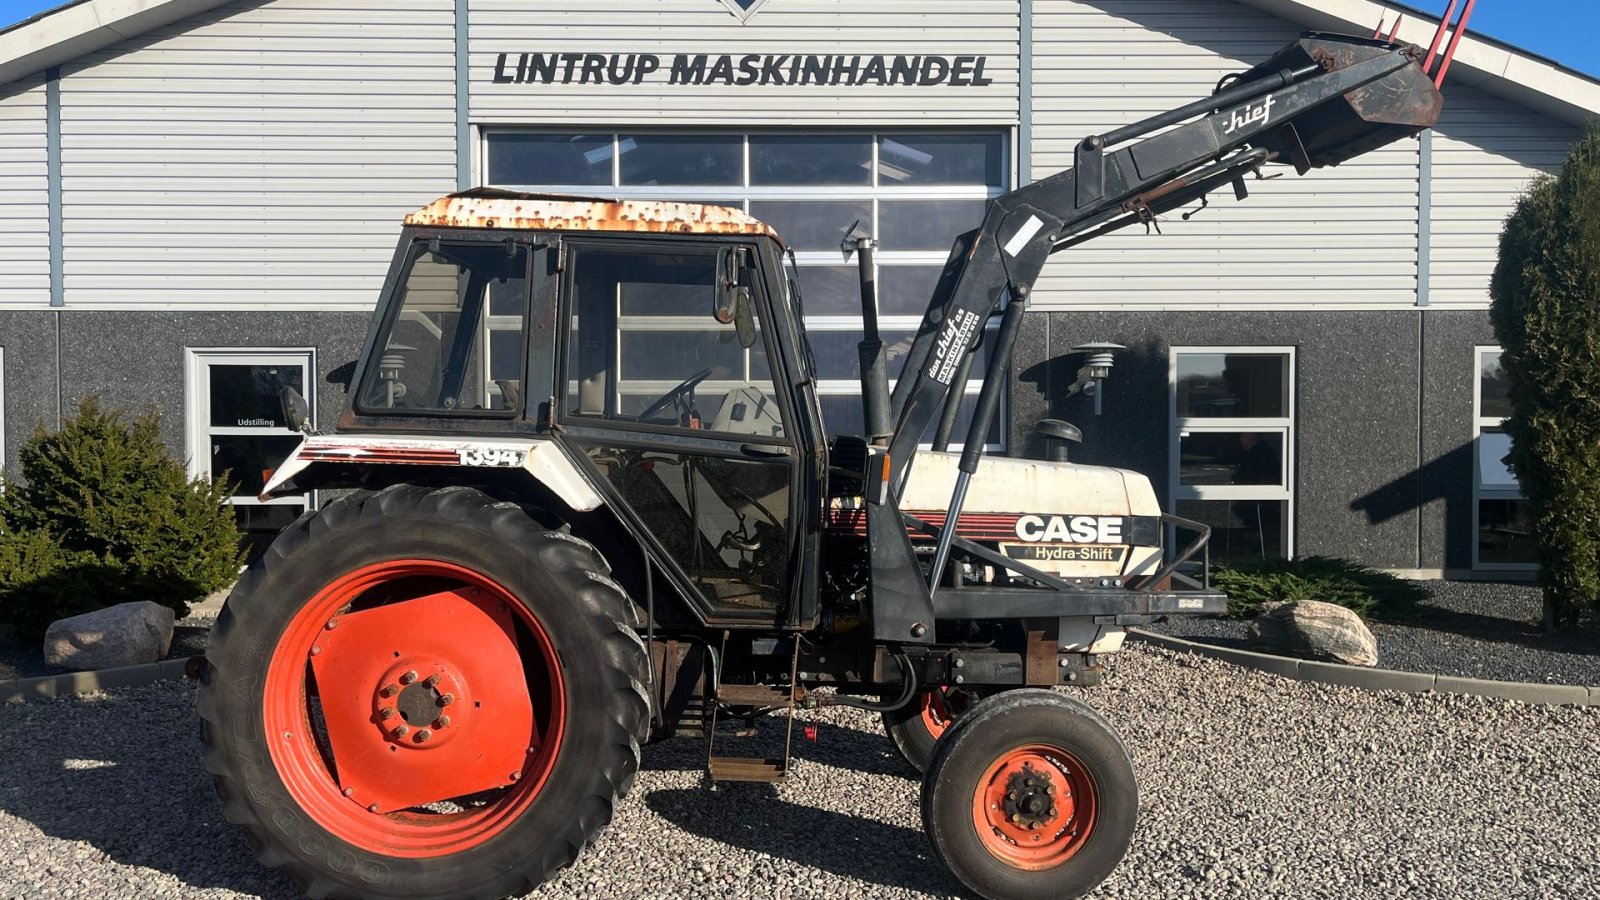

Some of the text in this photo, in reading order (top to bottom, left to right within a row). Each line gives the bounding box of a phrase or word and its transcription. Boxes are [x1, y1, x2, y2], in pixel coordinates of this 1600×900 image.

[492, 53, 994, 87] LINTRUP MASKINHANDEL
[1222, 94, 1276, 134] hief
[928, 359, 942, 379] dan
[936, 318, 961, 359] chief
[938, 312, 975, 382] MASKINFABRIK
[237, 418, 275, 428] Udstilling
[456, 448, 519, 466] 1394
[1015, 515, 1123, 543] CASE
[1035, 546, 1114, 560] Hydra-Shift
